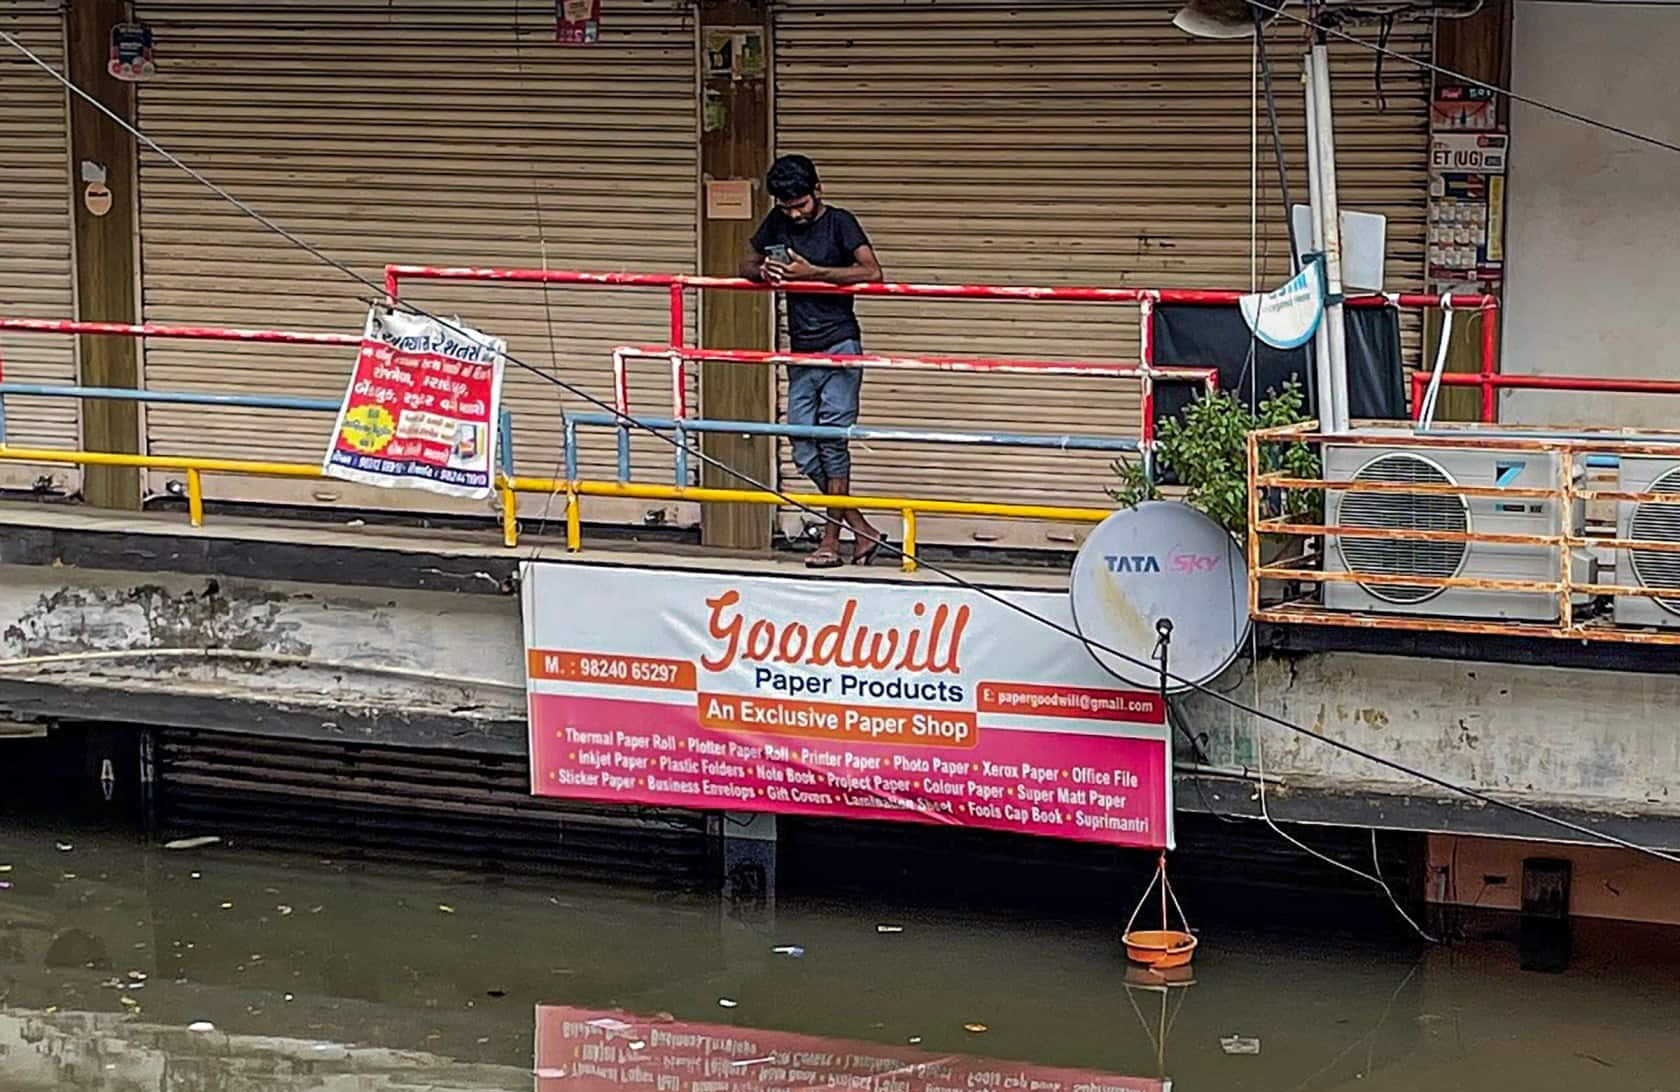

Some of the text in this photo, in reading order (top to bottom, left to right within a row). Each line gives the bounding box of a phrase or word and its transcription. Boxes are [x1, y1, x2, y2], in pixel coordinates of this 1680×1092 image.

[1455, 151, 1483, 168] (UG)
[1104, 556, 1160, 573] TATA
[701, 590, 970, 674] Goodwill
[580, 660, 628, 680] 98240
[631, 662, 679, 683] 65297
[756, 668, 964, 702] Paper Products
[707, 699, 969, 740] An Exclusive Paper Shop
[998, 690, 1153, 713] papergoodwill@gmail.com
[565, 728, 1138, 788] Thermal Paper Roll Plotter Paper Roll Printer Paper Photo Paper Xerox Paper Office File
[578, 750, 1126, 810] Inkjet Paper Plastic Folders Note Book Project Paper Colour Paper Super Matt Paper
[558, 769, 597, 787] Sticker
[599, 773, 636, 791] Paper
[648, 776, 700, 795] Business
[703, 781, 756, 800] Envelops
[767, 786, 789, 802] Gift
[791, 789, 833, 804] Covers
[968, 802, 1001, 818] Fools
[1004, 805, 1029, 824] Cap
[1031, 808, 1063, 825] Book
[1075, 811, 1149, 833] Suprimantri
